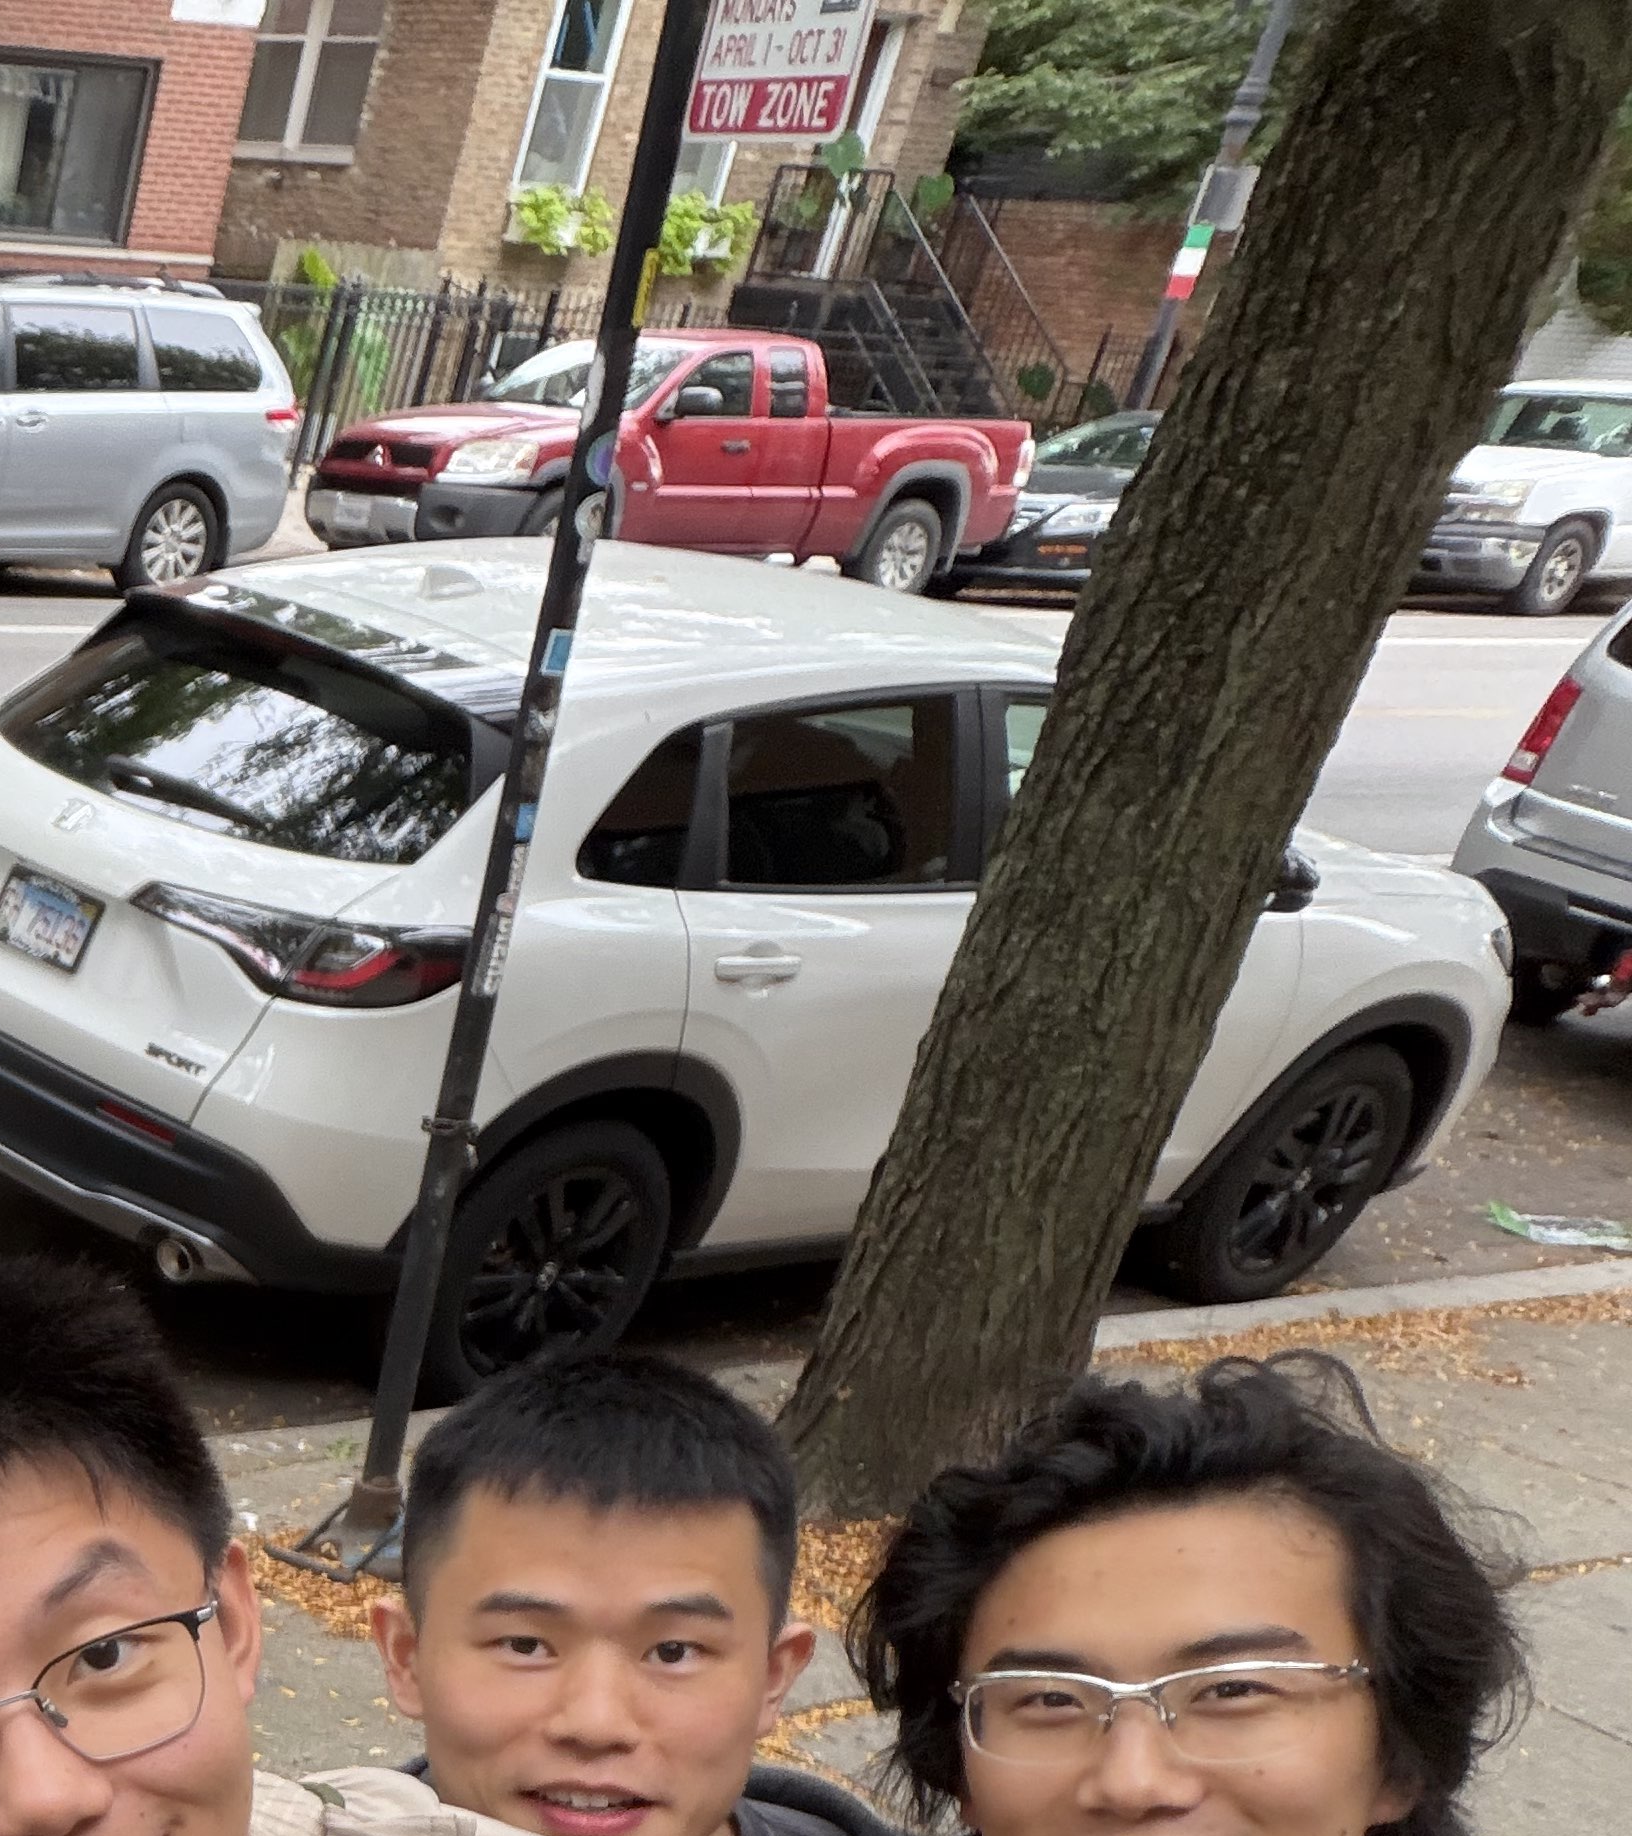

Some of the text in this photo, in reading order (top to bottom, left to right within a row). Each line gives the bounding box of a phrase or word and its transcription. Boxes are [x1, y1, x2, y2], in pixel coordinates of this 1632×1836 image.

[710, 33, 757, 67] APRIL
[788, 28, 826, 65] OCT
[698, 80, 838, 128] TOW ZONE
[143, 1041, 207, 1077] SPORT
